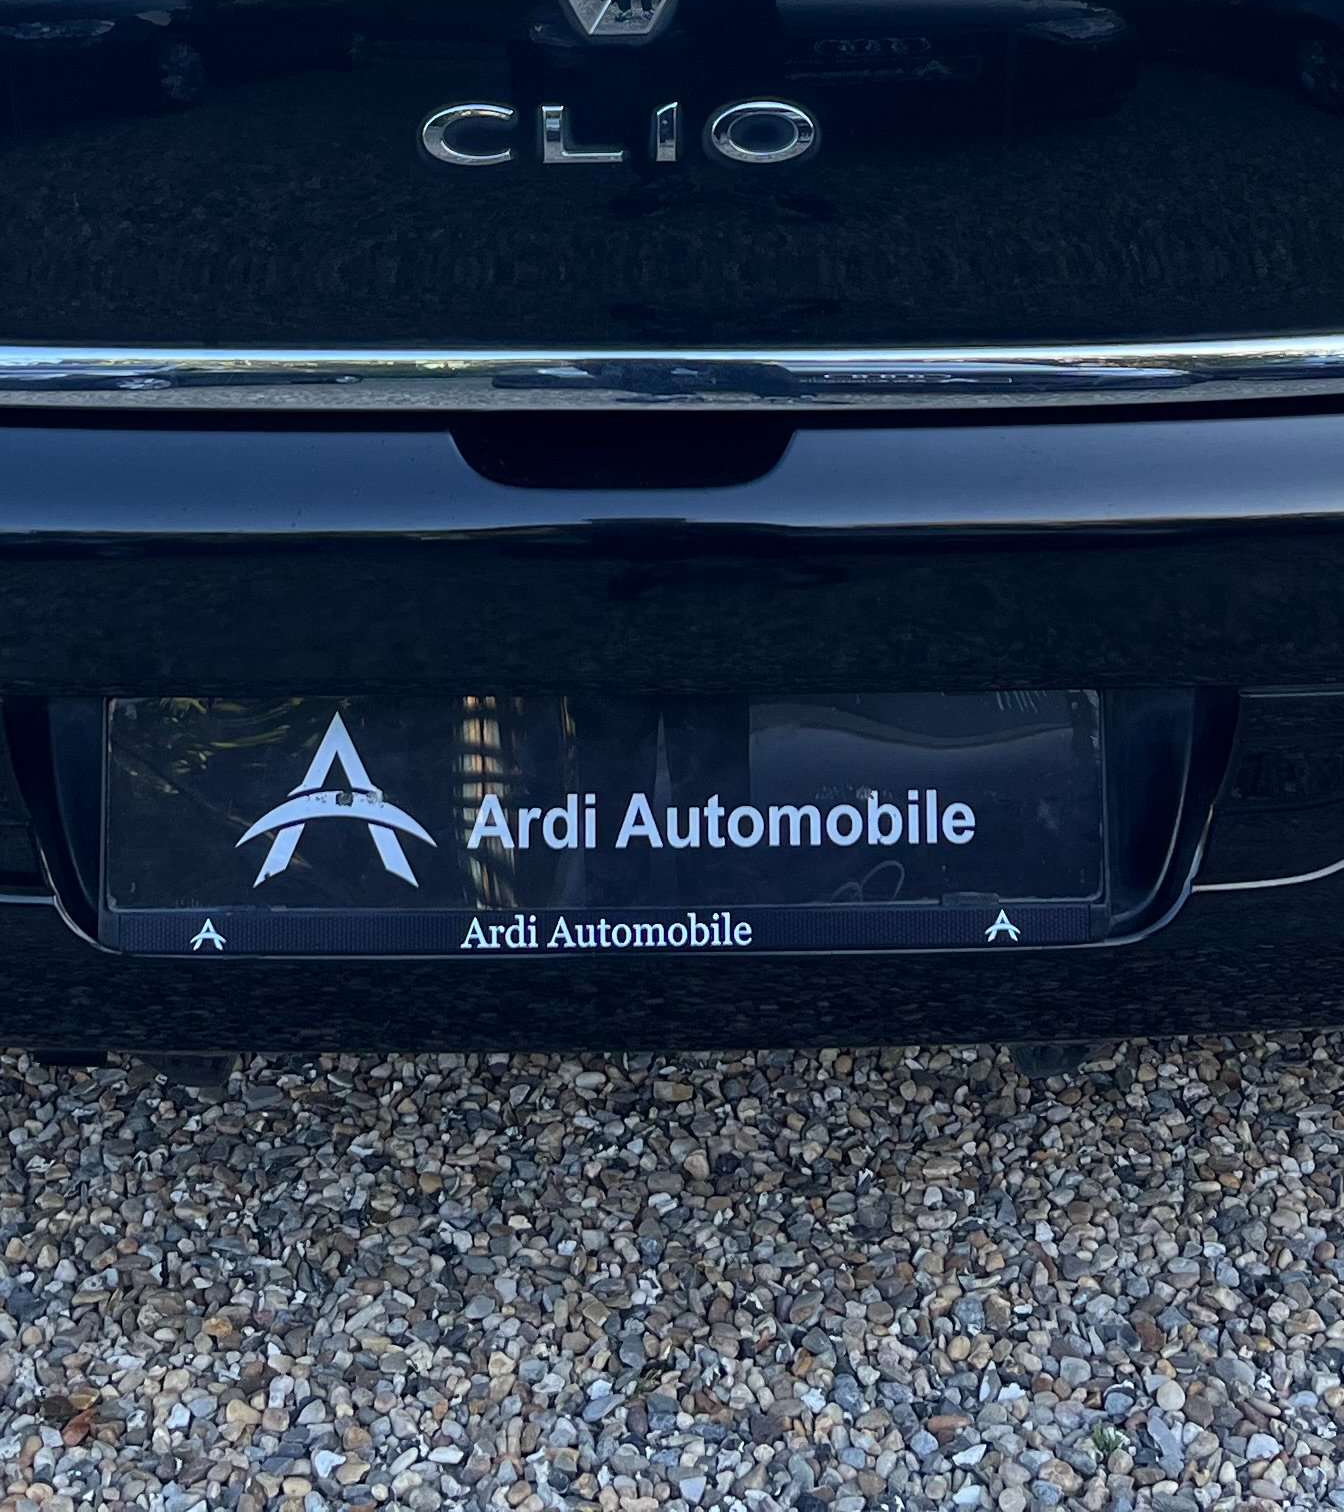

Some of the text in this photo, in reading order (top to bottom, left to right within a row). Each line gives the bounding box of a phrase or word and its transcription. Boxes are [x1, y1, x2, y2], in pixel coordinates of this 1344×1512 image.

[422, 101, 816, 166] CLIO
[465, 793, 597, 850] Ardi
[614, 789, 976, 849] Automobile
[459, 914, 538, 949] Ardi
[546, 912, 753, 948] Automobile
